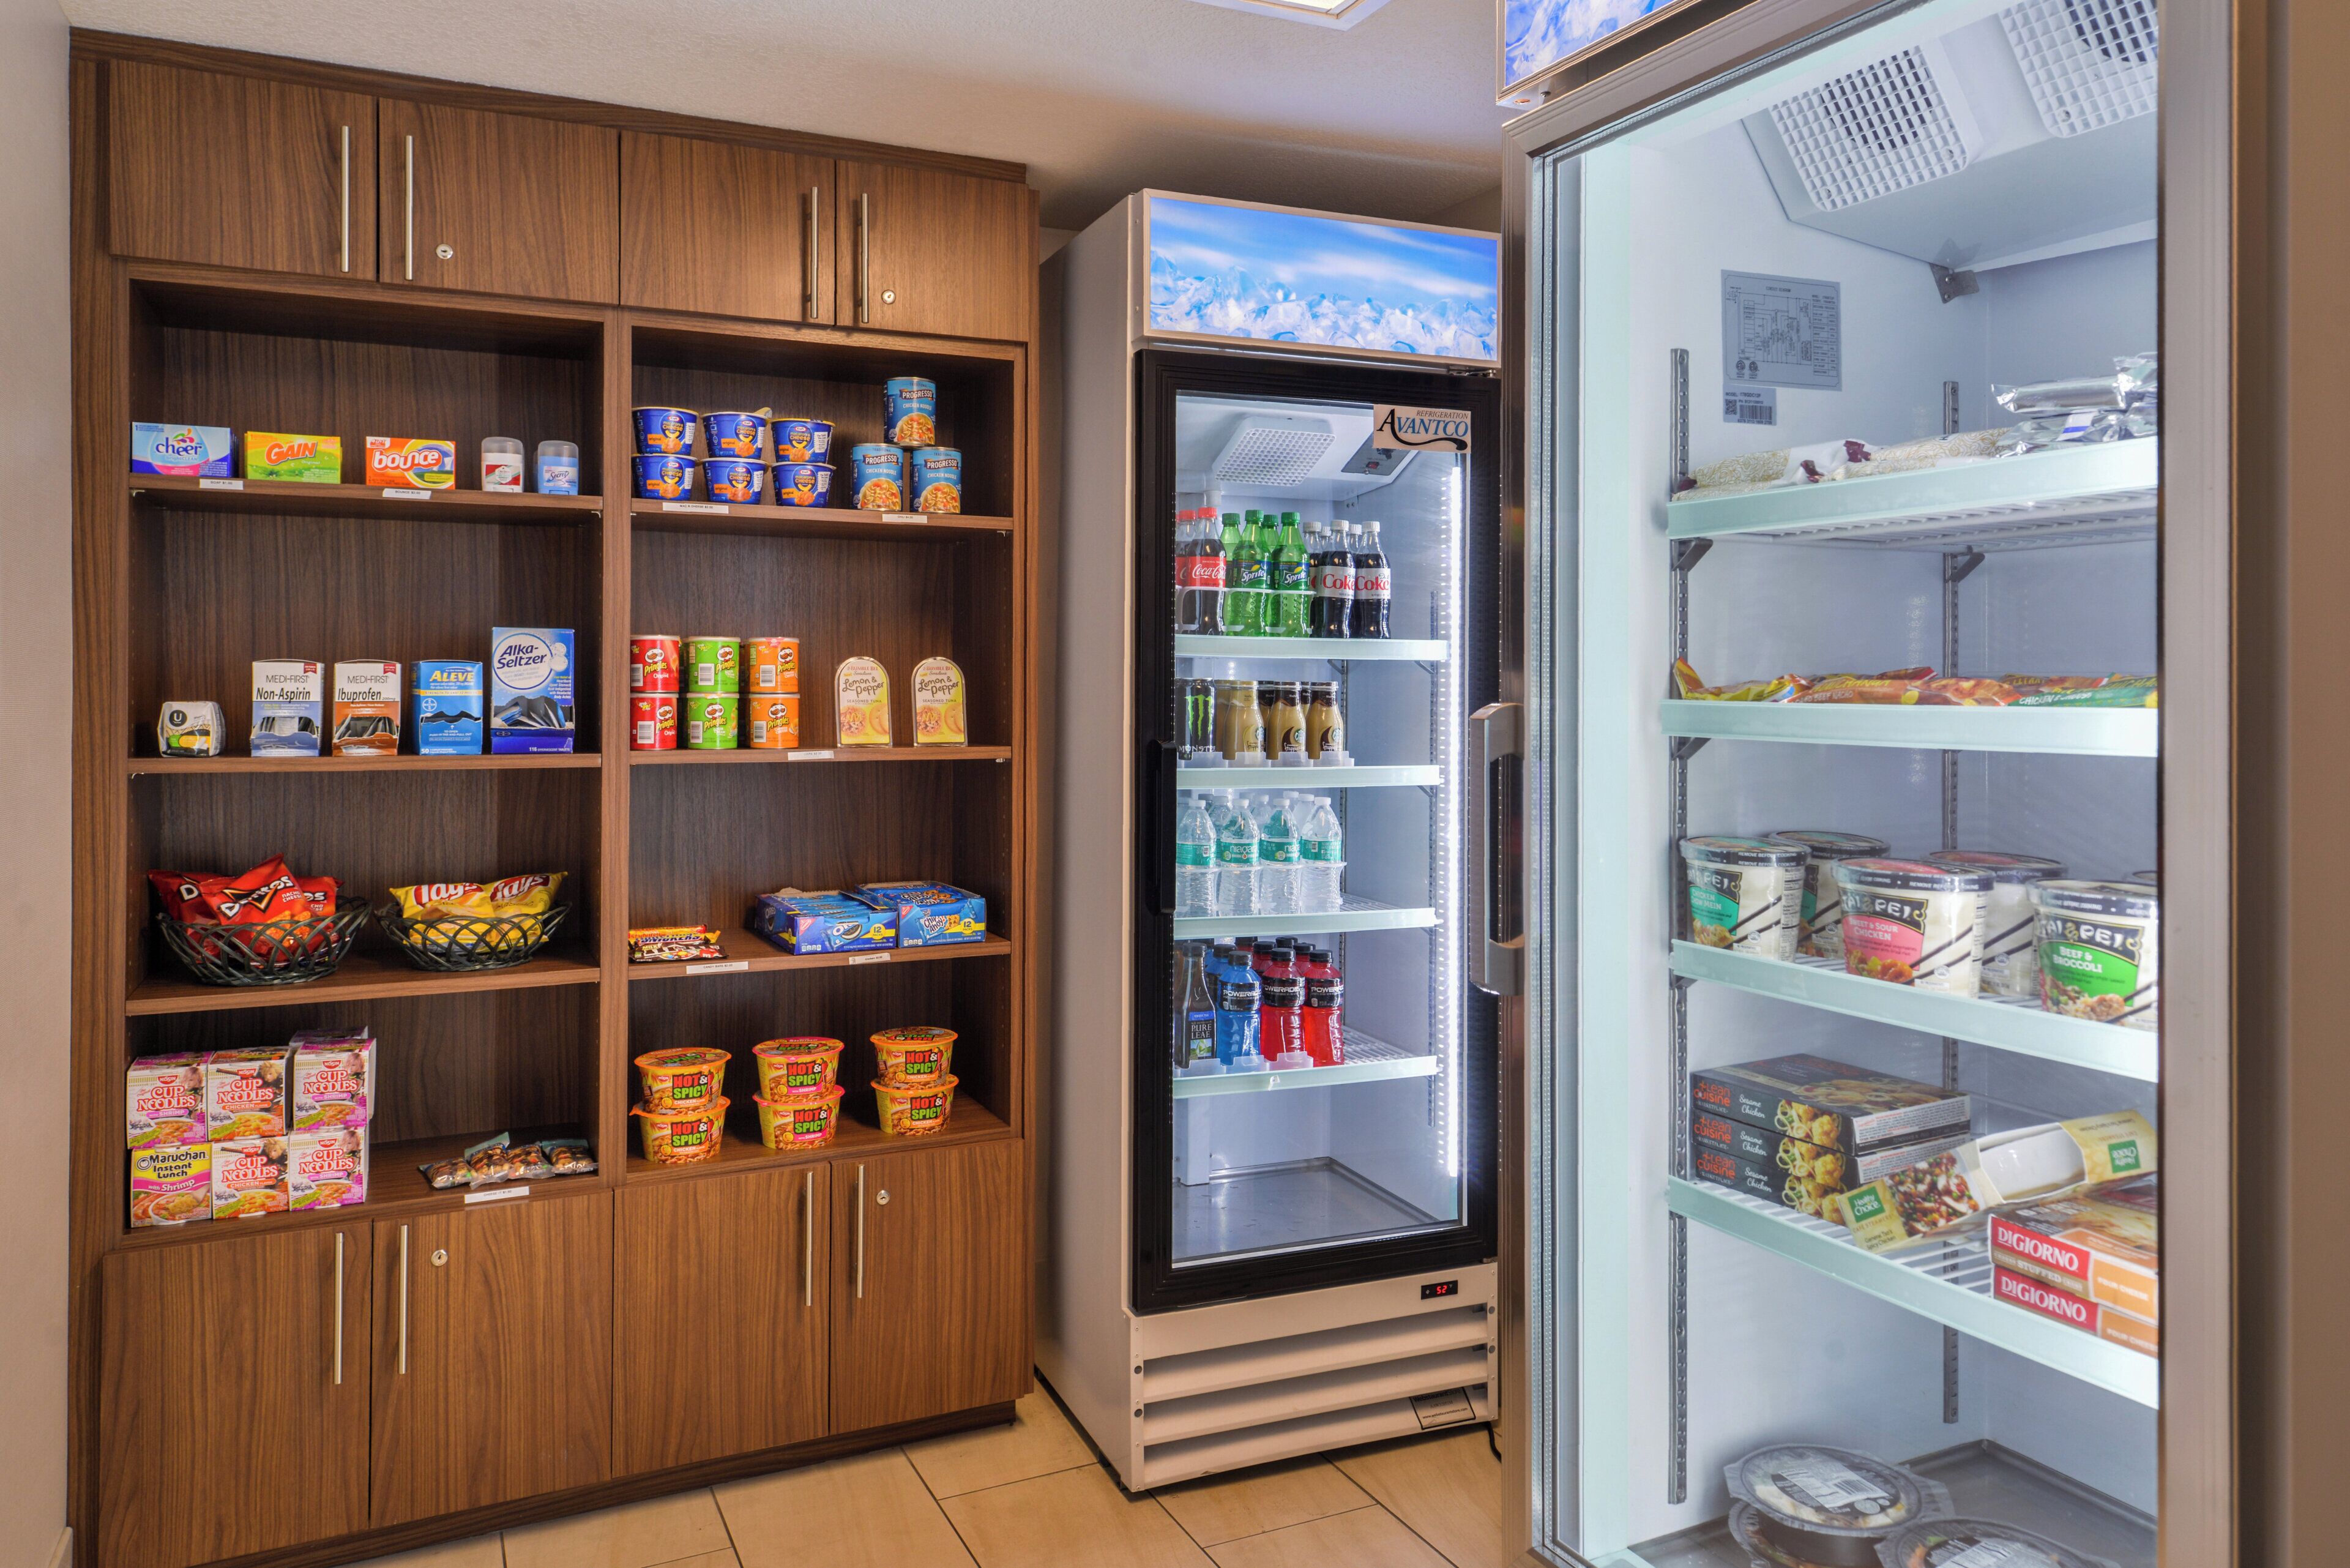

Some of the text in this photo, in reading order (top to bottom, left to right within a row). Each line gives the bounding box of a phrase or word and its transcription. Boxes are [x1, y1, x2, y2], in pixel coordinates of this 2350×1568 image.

[902, 390, 933, 400] PROGRESSO
[1416, 409, 1469, 420] REFRIGERATION
[1376, 408, 1469, 439] AVANTCO
[155, 437, 202, 456] cheer
[266, 441, 318, 465] GAIN
[373, 450, 439, 469] bounce
[865, 454, 897, 465] PROGRESSO
[927, 459, 958, 469] PROGRESSO
[550, 471, 569, 480] Secret
[1192, 563, 1226, 579] Coca-Cola
[1241, 569, 1265, 582] Sprite
[1285, 570, 1307, 584] Sprite
[1322, 573, 1354, 591] Coke
[1356, 575, 1389, 591] Coke
[499, 644, 539, 658] Alka-
[496, 653, 547, 670] Seltzer
[644, 661, 667, 676] Pringles
[715, 660, 736, 674] Pringles
[777, 661, 796, 676] Pringles
[266, 674, 309, 684] MEDI-FIRST
[347, 675, 389, 684] MEDI-FIRST
[430, 670, 475, 682] ALEVE
[841, 678, 870, 692] Lemon
[856, 681, 884, 698] Pepper
[917, 678, 945, 692] Lemon
[931, 681, 960, 698] Pepper
[256, 687, 311, 703] Non-Aspirin
[338, 687, 381, 703] Ibuprofen
[655, 719, 674, 734] Pringles
[704, 717, 727, 732] Pringles
[767, 716, 789, 732] Pringles
[1703, 872, 1729, 889] PEI
[1704, 901, 1722, 910] MEIN
[1874, 898, 1912, 919] PEI
[930, 916, 946, 933] Ahoy!
[1850, 918, 1898, 933] SWEET SOUR
[2080, 925, 2124, 948] PEI
[2059, 946, 2093, 961] BEEF &
[2052, 954, 2103, 974] BROCCOLI
[1191, 1023, 1212, 1032] PURE
[906, 1061, 937, 1074] SPICY
[316, 1070, 348, 1083] CUP
[788, 1072, 821, 1086] SPICY
[151, 1086, 184, 1098] CUP
[231, 1079, 263, 1091] CUP
[303, 1079, 359, 1094] NOODLES
[673, 1085, 707, 1099] SPICY
[1706, 1083, 1731, 1097] Lean
[137, 1095, 195, 1111] NOODLES
[217, 1088, 274, 1104] NOODLES
[1739, 1094, 1762, 1108] Sesame
[911, 1105, 942, 1120] SPICY
[1741, 1105, 1766, 1119] Chicken
[795, 1119, 827, 1133] SPICY
[1706, 1119, 1732, 1133] Lean
[672, 1132, 707, 1147] SPICY
[1740, 1131, 1762, 1144] Sesame
[312, 1149, 343, 1162] CUP
[1742, 1141, 1767, 1156] Chicken
[149, 1151, 206, 1163] Maruchan
[236, 1156, 267, 1169] CUP
[1709, 1154, 1736, 1170] Lean
[153, 1162, 192, 1172] Instant
[299, 1158, 354, 1174] NOODLES
[157, 1170, 187, 1179] Lunch
[222, 1166, 279, 1182] NOODLES
[1745, 1167, 1768, 1182] Sesame
[161, 1179, 195, 1192] Shrimp
[1747, 1179, 1772, 1193] Chicken
[1854, 1194, 1875, 1208] Healthy
[1854, 1201, 1881, 1216] Choice
[1997, 1226, 2078, 1271] DIGIORNO
[2016, 1259, 2062, 1283] STUFFED
[1436, 1285, 1447, 1294] 52
[2097, 1276, 2149, 1301] FOUR CHEESE
[2001, 1276, 2087, 1322] DIGIORNO
[2106, 1328, 2128, 1341] FOUR
[1422, 1407, 1468, 1419] www.webstaurantstore.com
